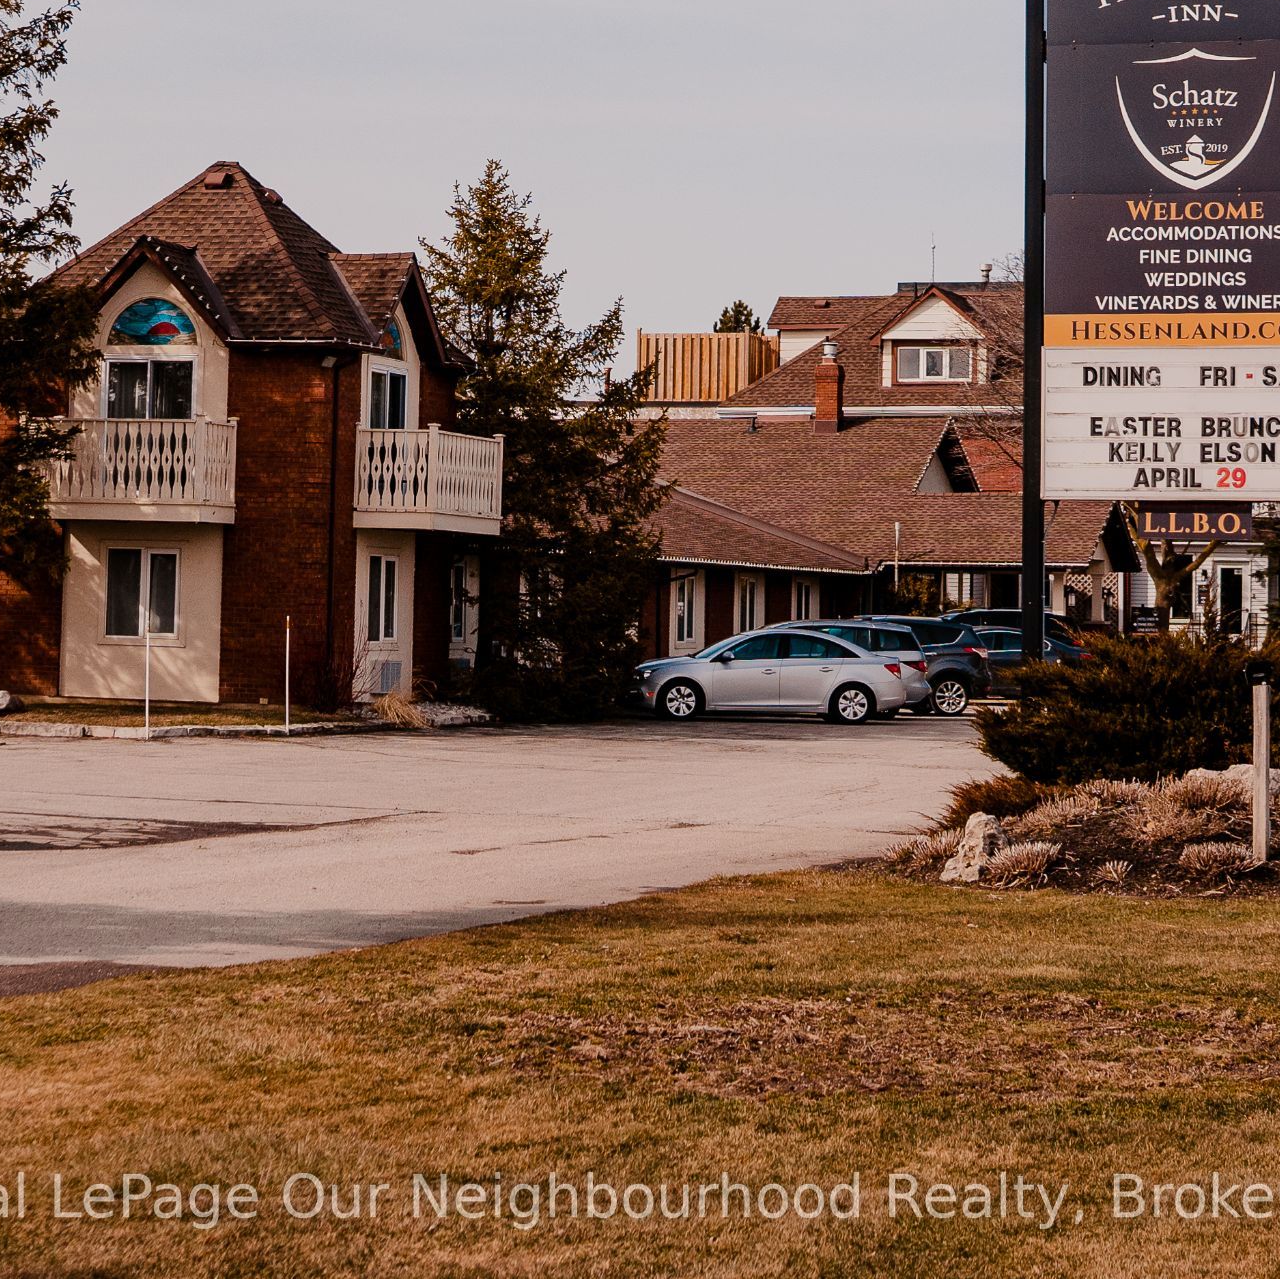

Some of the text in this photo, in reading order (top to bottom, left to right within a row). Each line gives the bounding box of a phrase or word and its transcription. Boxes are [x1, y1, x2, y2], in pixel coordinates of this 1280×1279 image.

[1152, 80, 1238, 109] Schatz
[1167, 117, 1223, 128] WINERY
[1161, 143, 1228, 155] EST. 2019
[1126, 200, 1265, 221] WELCOME
[1139, 248, 1252, 264] FINE DINING
[1144, 271, 1247, 287] WEDDINGS
[1095, 295, 1199, 310] VINEYARDS
[1204, 295, 1217, 310] &
[1082, 366, 1161, 387] DINING
[1199, 366, 1235, 387] FRI
[1090, 416, 1182, 437] EASTER
[1108, 442, 1276, 463] KELLY ELSON
[1133, 467, 1247, 488] APRIL 29
[1143, 511, 1247, 535] L.L.B.O.
